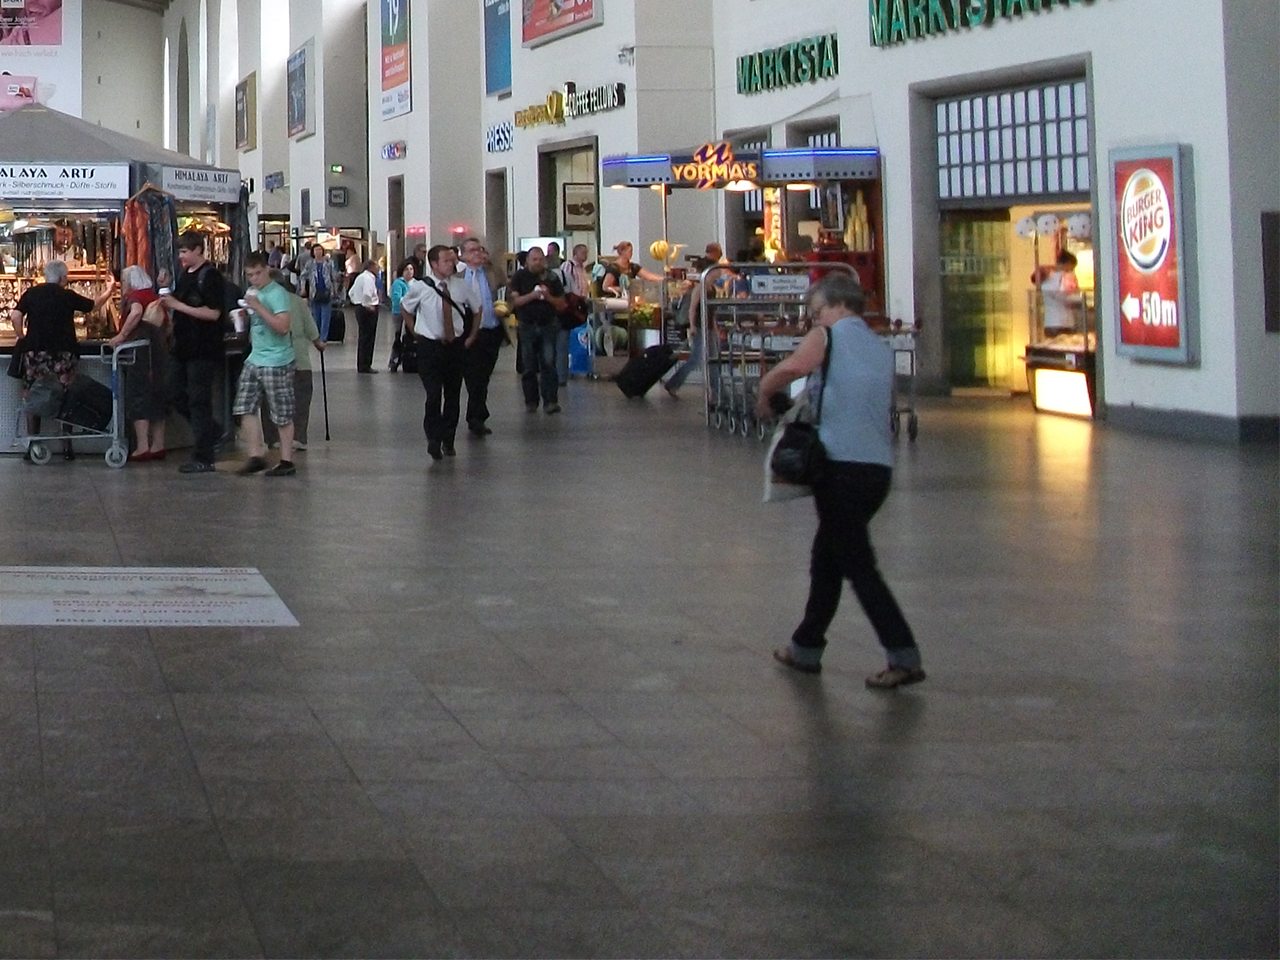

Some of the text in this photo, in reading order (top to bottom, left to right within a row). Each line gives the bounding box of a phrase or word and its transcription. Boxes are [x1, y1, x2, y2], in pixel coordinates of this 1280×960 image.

[33, 49, 58, 57] verliebt
[736, 32, 839, 95] MARKTSTA
[590, 82, 619, 111] FELLOWS
[59, 167, 96, 179] ARTS
[174, 170, 229, 184] HIMALAYA ARTS
[672, 161, 758, 182] YORMA'S
[12, 181, 65, 189] Silberschmuck
[1127, 188, 1162, 223] BURGER
[1129, 206, 1164, 247] KING
[1142, 292, 1177, 327] 50m
